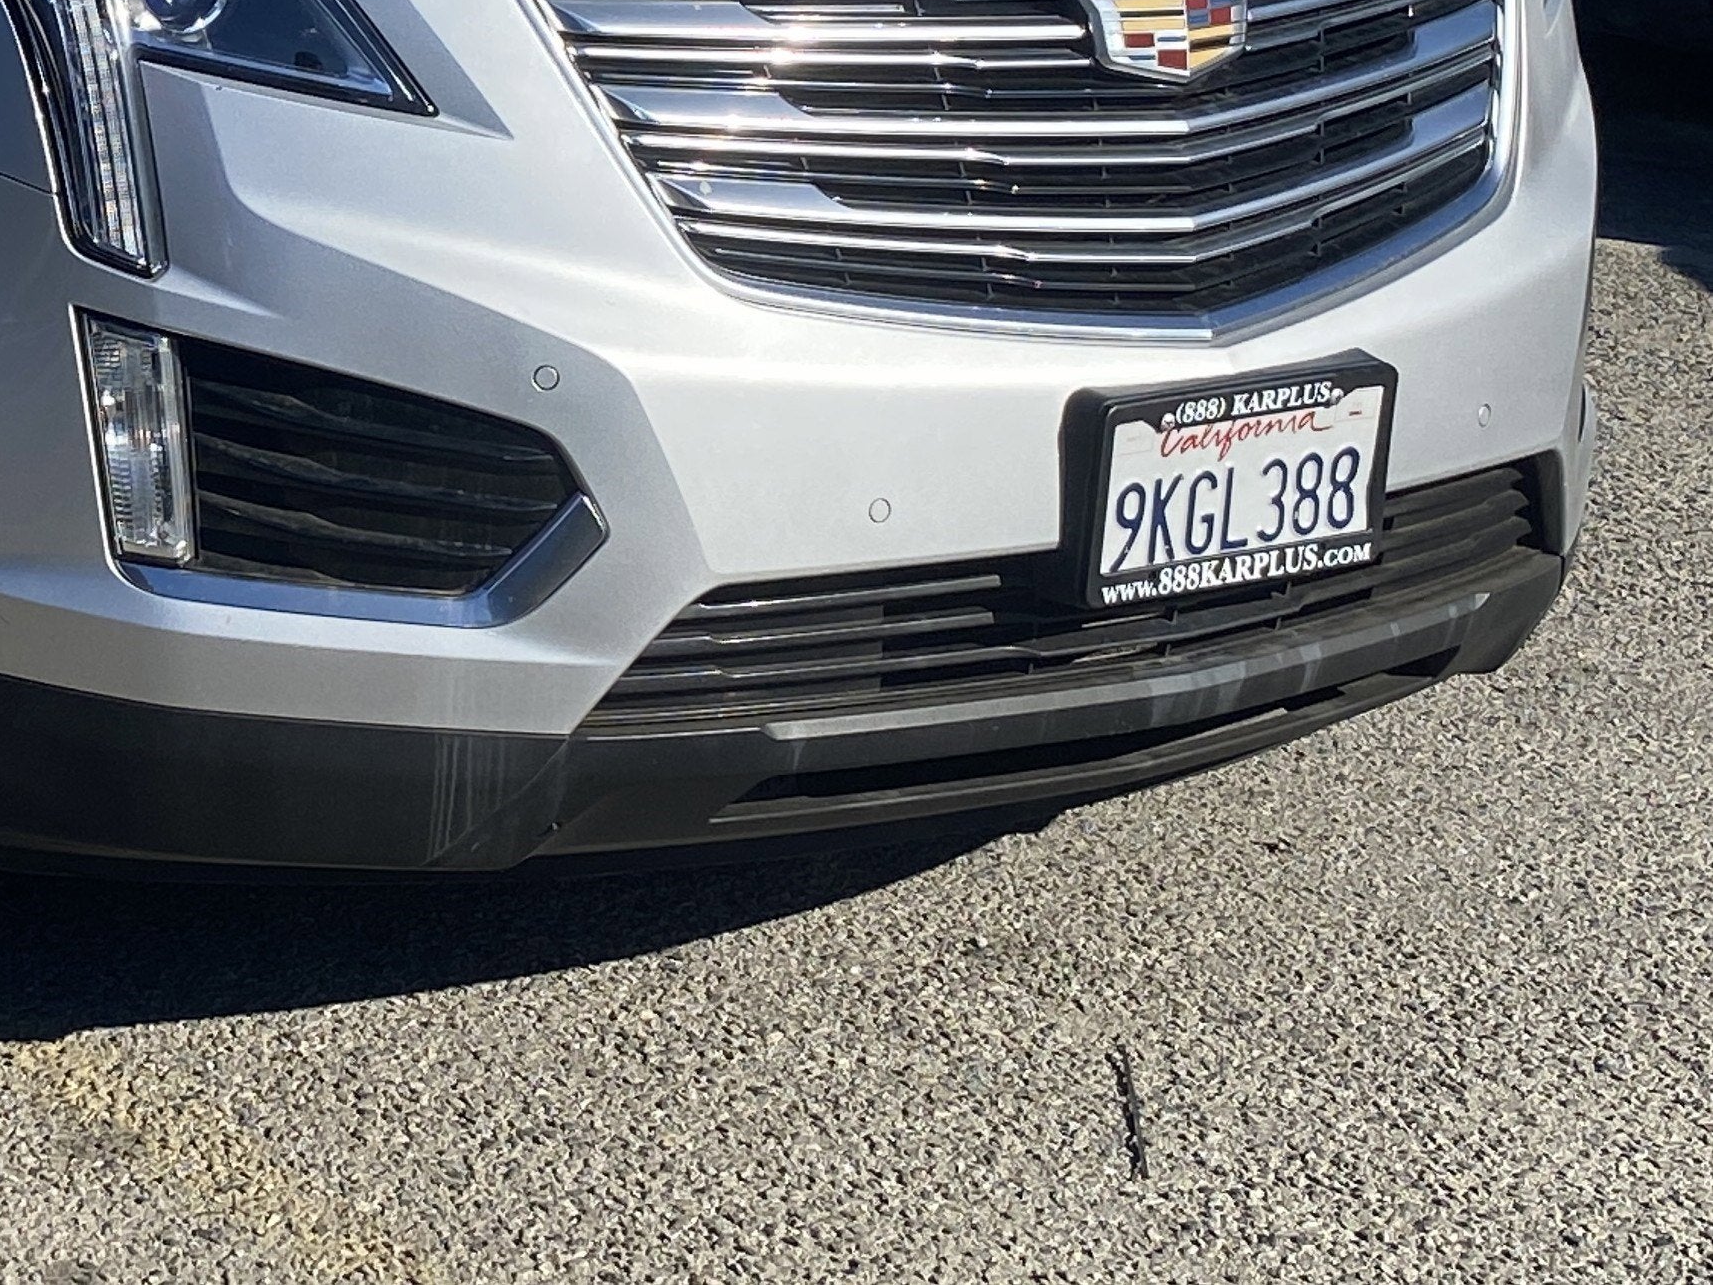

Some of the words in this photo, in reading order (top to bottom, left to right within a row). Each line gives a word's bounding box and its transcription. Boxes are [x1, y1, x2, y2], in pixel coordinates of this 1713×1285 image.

[1175, 397, 1226, 424] (888)
[1231, 381, 1332, 416] KARPLUS
[1159, 411, 1334, 462] California
[1109, 446, 1361, 572] 9KGL388
